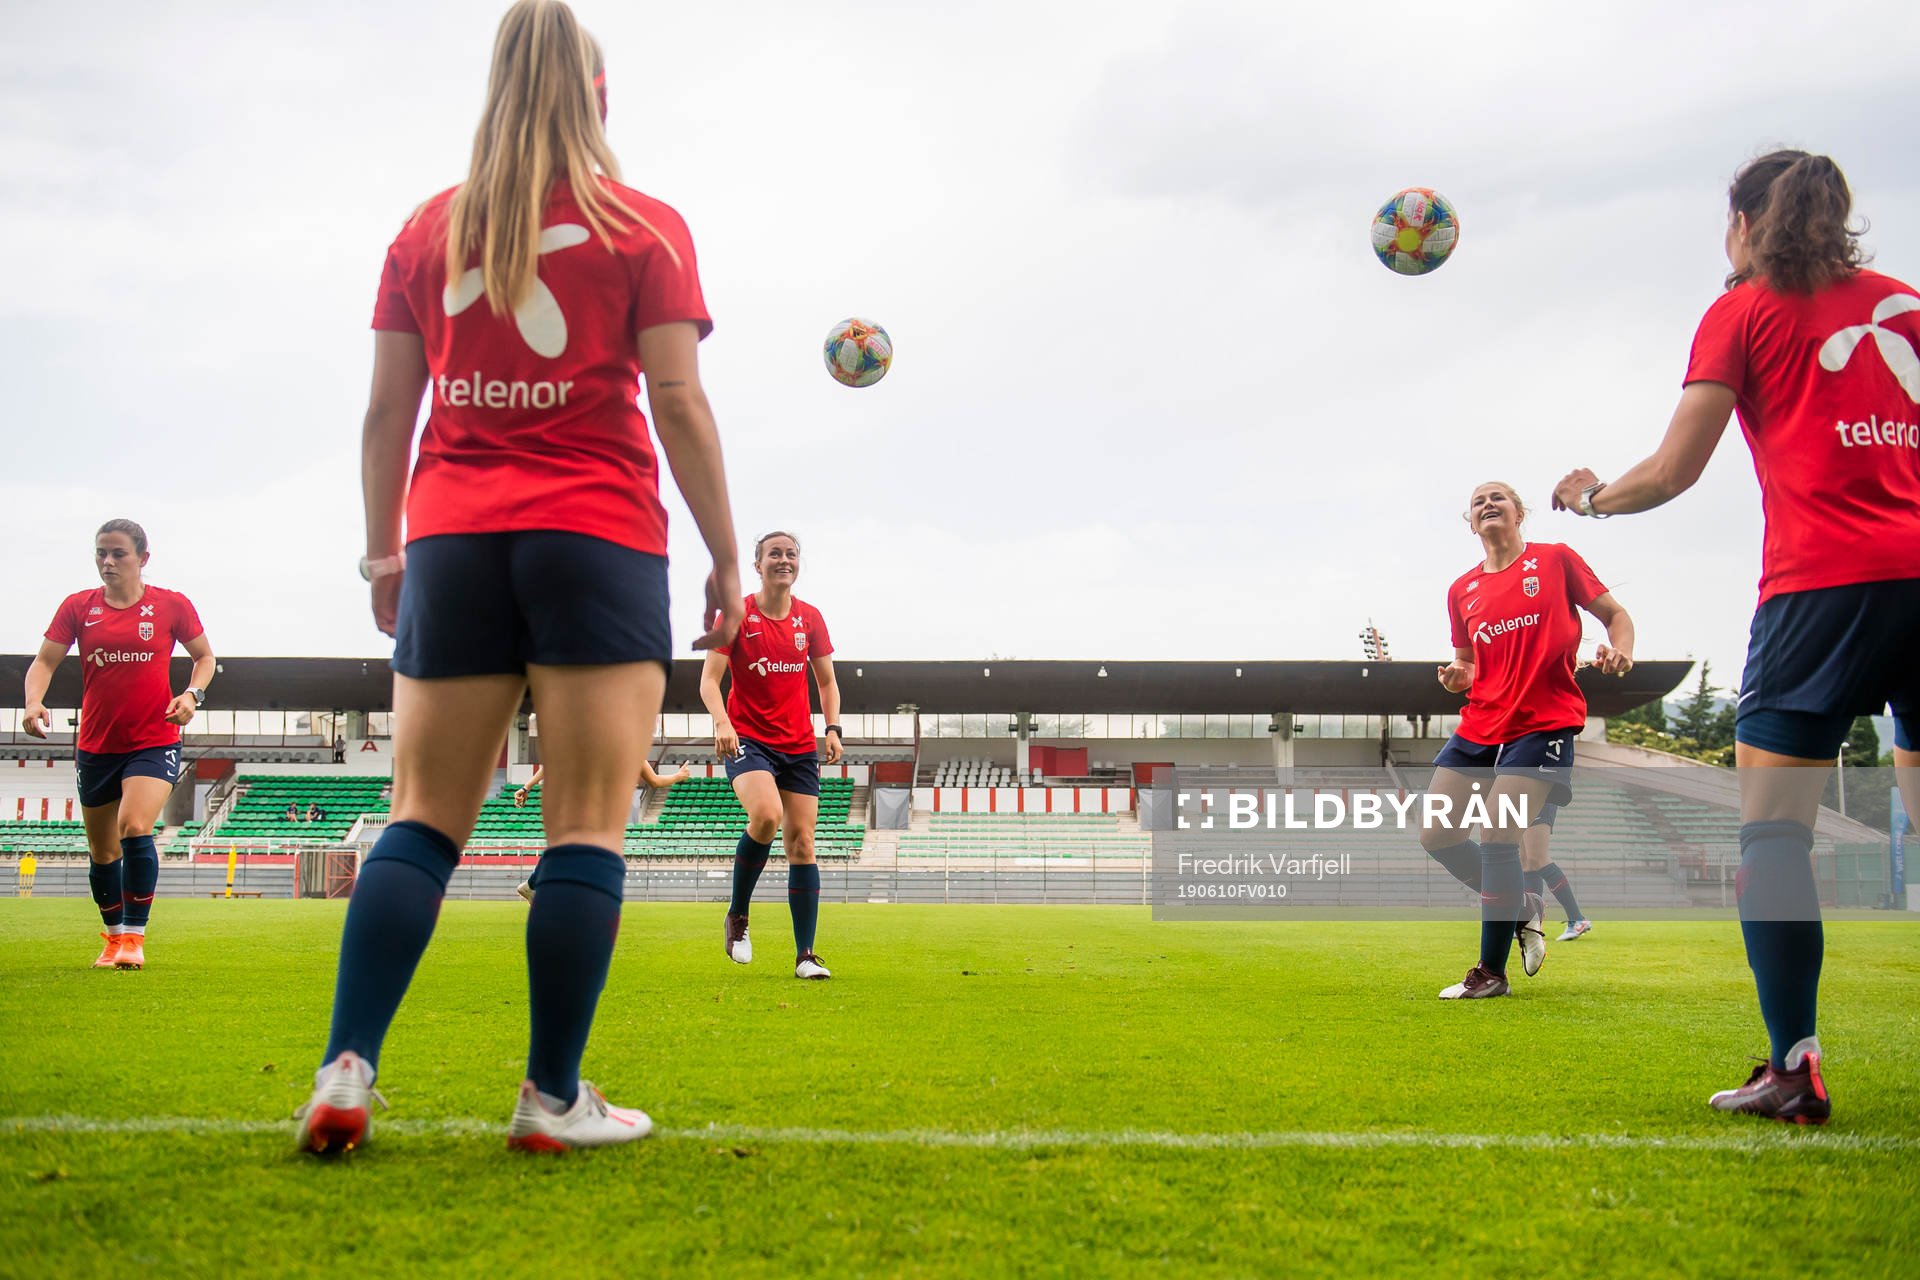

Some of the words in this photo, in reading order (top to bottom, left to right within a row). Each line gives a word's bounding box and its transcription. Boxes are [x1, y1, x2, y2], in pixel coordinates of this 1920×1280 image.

[438, 371, 574, 409] telenor
[1835, 414, 1919, 449] teleno
[1488, 613, 1540, 637] telenor
[103, 649, 154, 663] telenor
[767, 660, 804, 673] telenor
[360, 741, 378, 752] A
